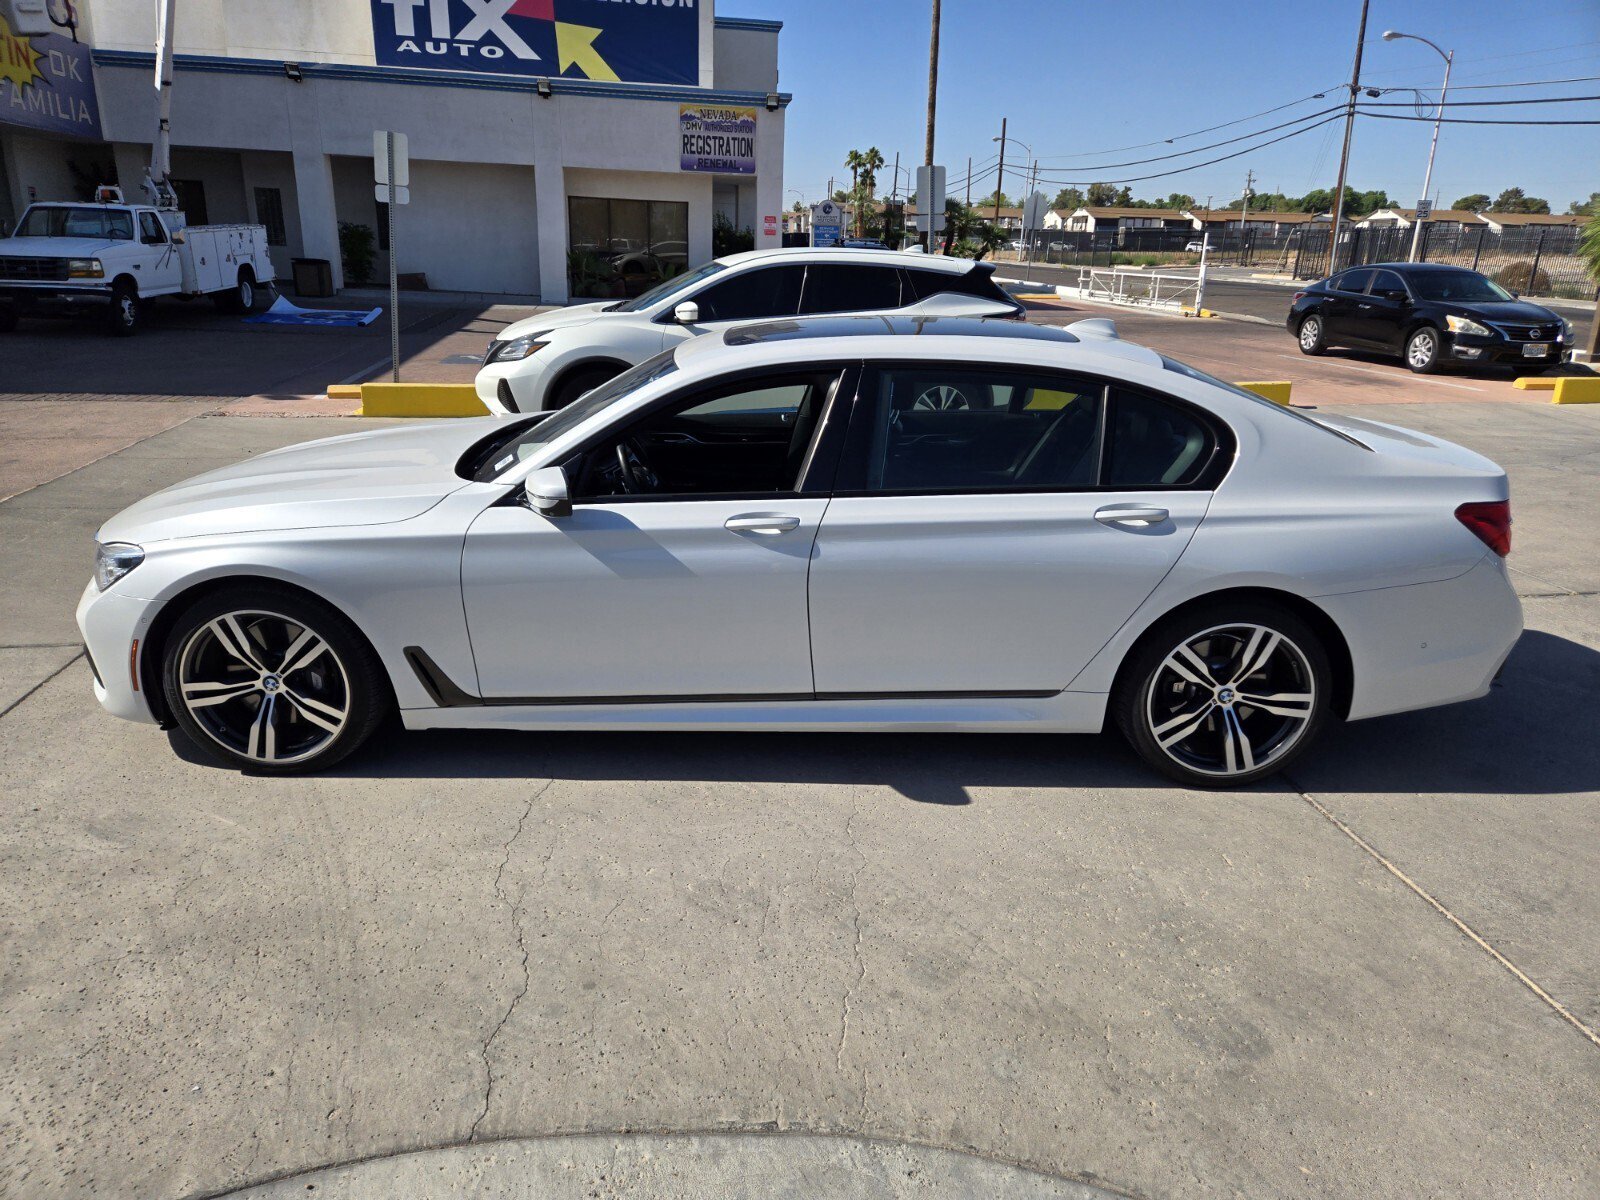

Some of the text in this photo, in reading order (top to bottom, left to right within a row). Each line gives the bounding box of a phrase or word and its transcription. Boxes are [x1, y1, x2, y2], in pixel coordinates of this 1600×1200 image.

[396, 40, 505, 58] AUTO
[700, 109, 738, 121] NEVADA
[685, 121, 703, 131] DMV
[705, 124, 733, 133] AUTHORIZED
[682, 134, 753, 157] REGISTRATION
[697, 158, 739, 169] RENEWAL
